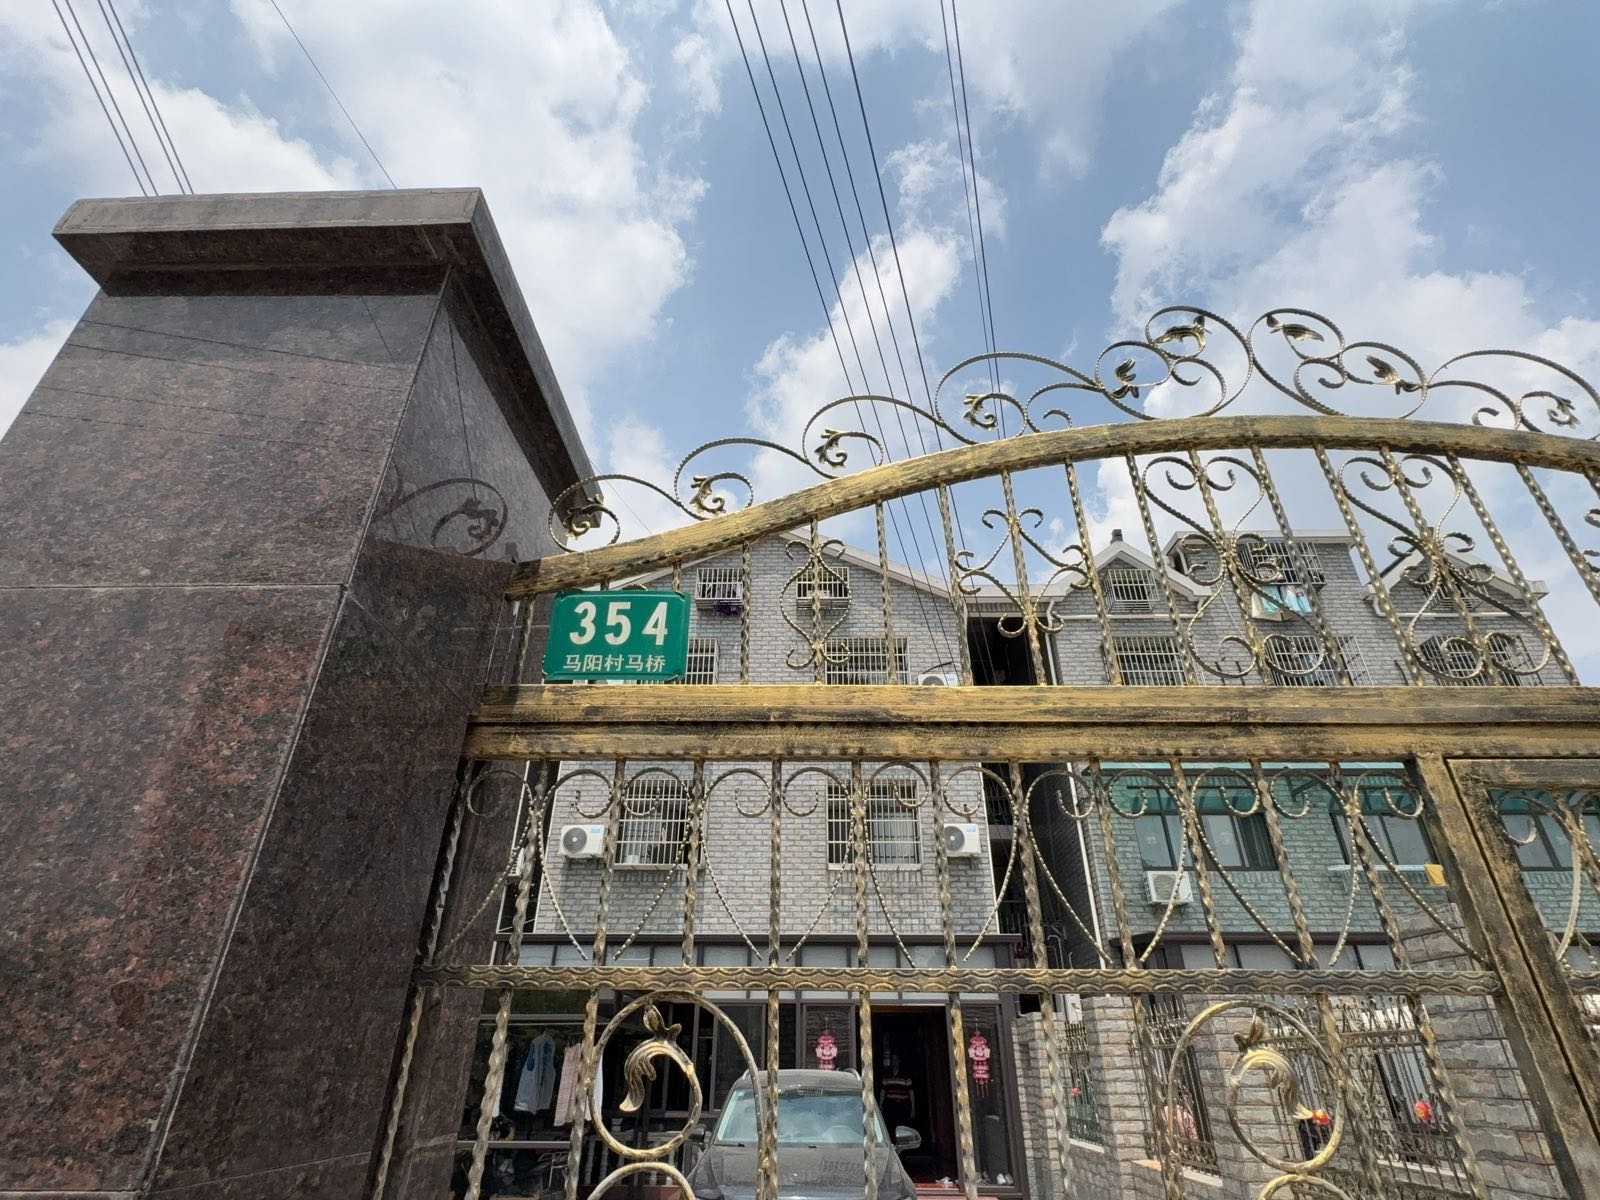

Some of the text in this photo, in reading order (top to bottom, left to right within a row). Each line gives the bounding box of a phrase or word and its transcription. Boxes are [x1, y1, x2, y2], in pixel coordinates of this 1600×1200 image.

[569, 601, 668, 646] 354
[562, 654, 666, 673] 马阳村马桥
